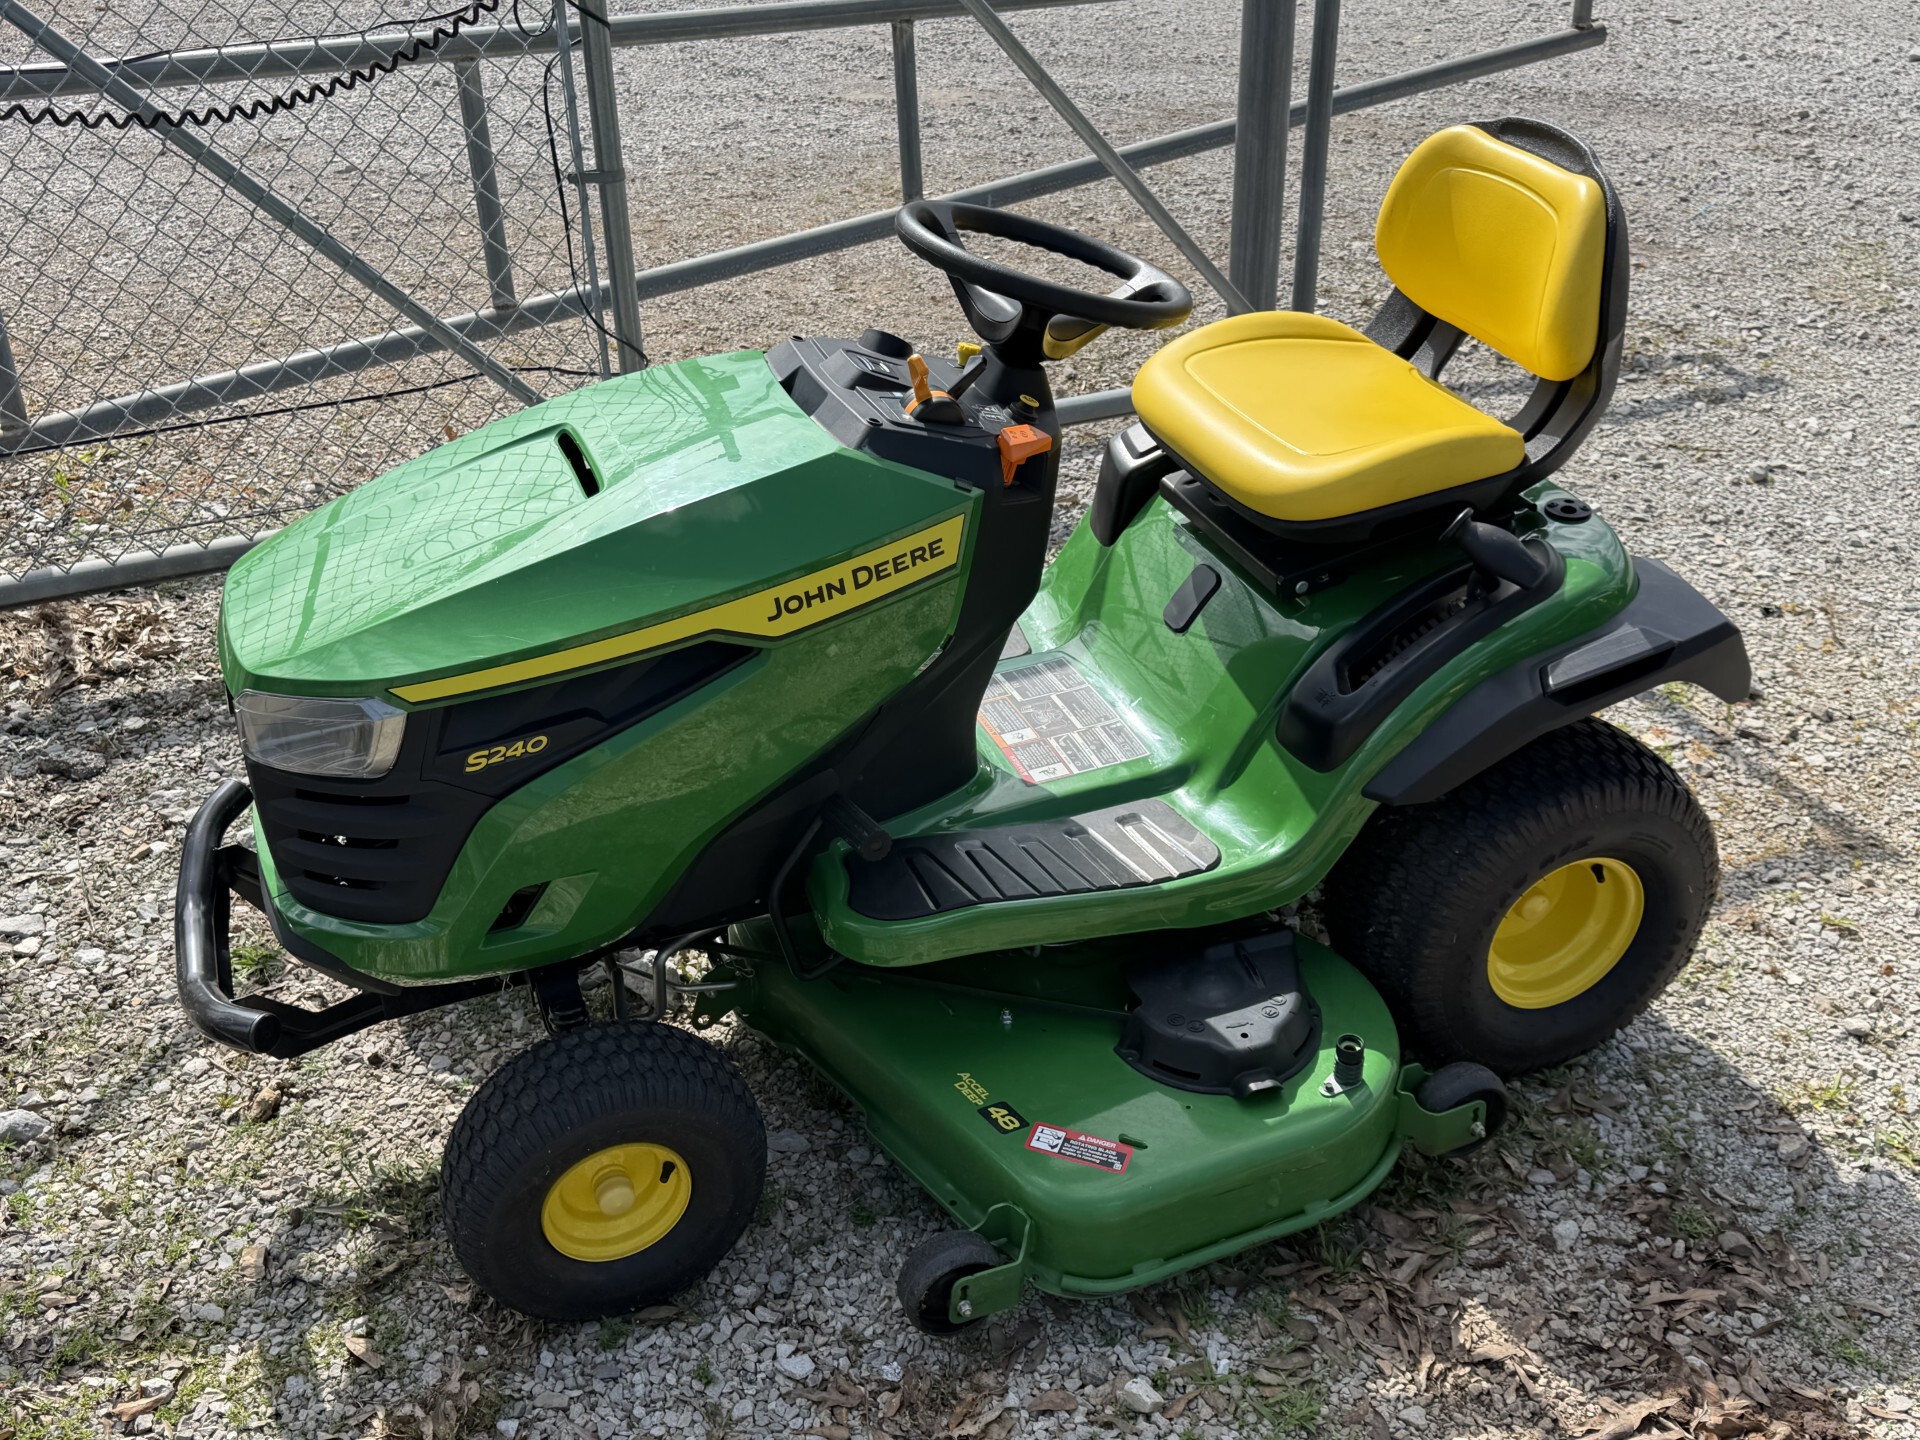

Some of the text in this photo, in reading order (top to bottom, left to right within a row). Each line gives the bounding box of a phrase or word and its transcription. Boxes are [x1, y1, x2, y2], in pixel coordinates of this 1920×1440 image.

[767, 537, 945, 622] JOHN DEERE
[465, 735, 548, 773] S240
[954, 1081, 984, 1105] DEEP
[957, 1072, 989, 1099] ACCEL
[988, 1107, 1020, 1130] 48
[1070, 1140, 1097, 1150] ROTATING
[1087, 1137, 1116, 1148] DANGER
